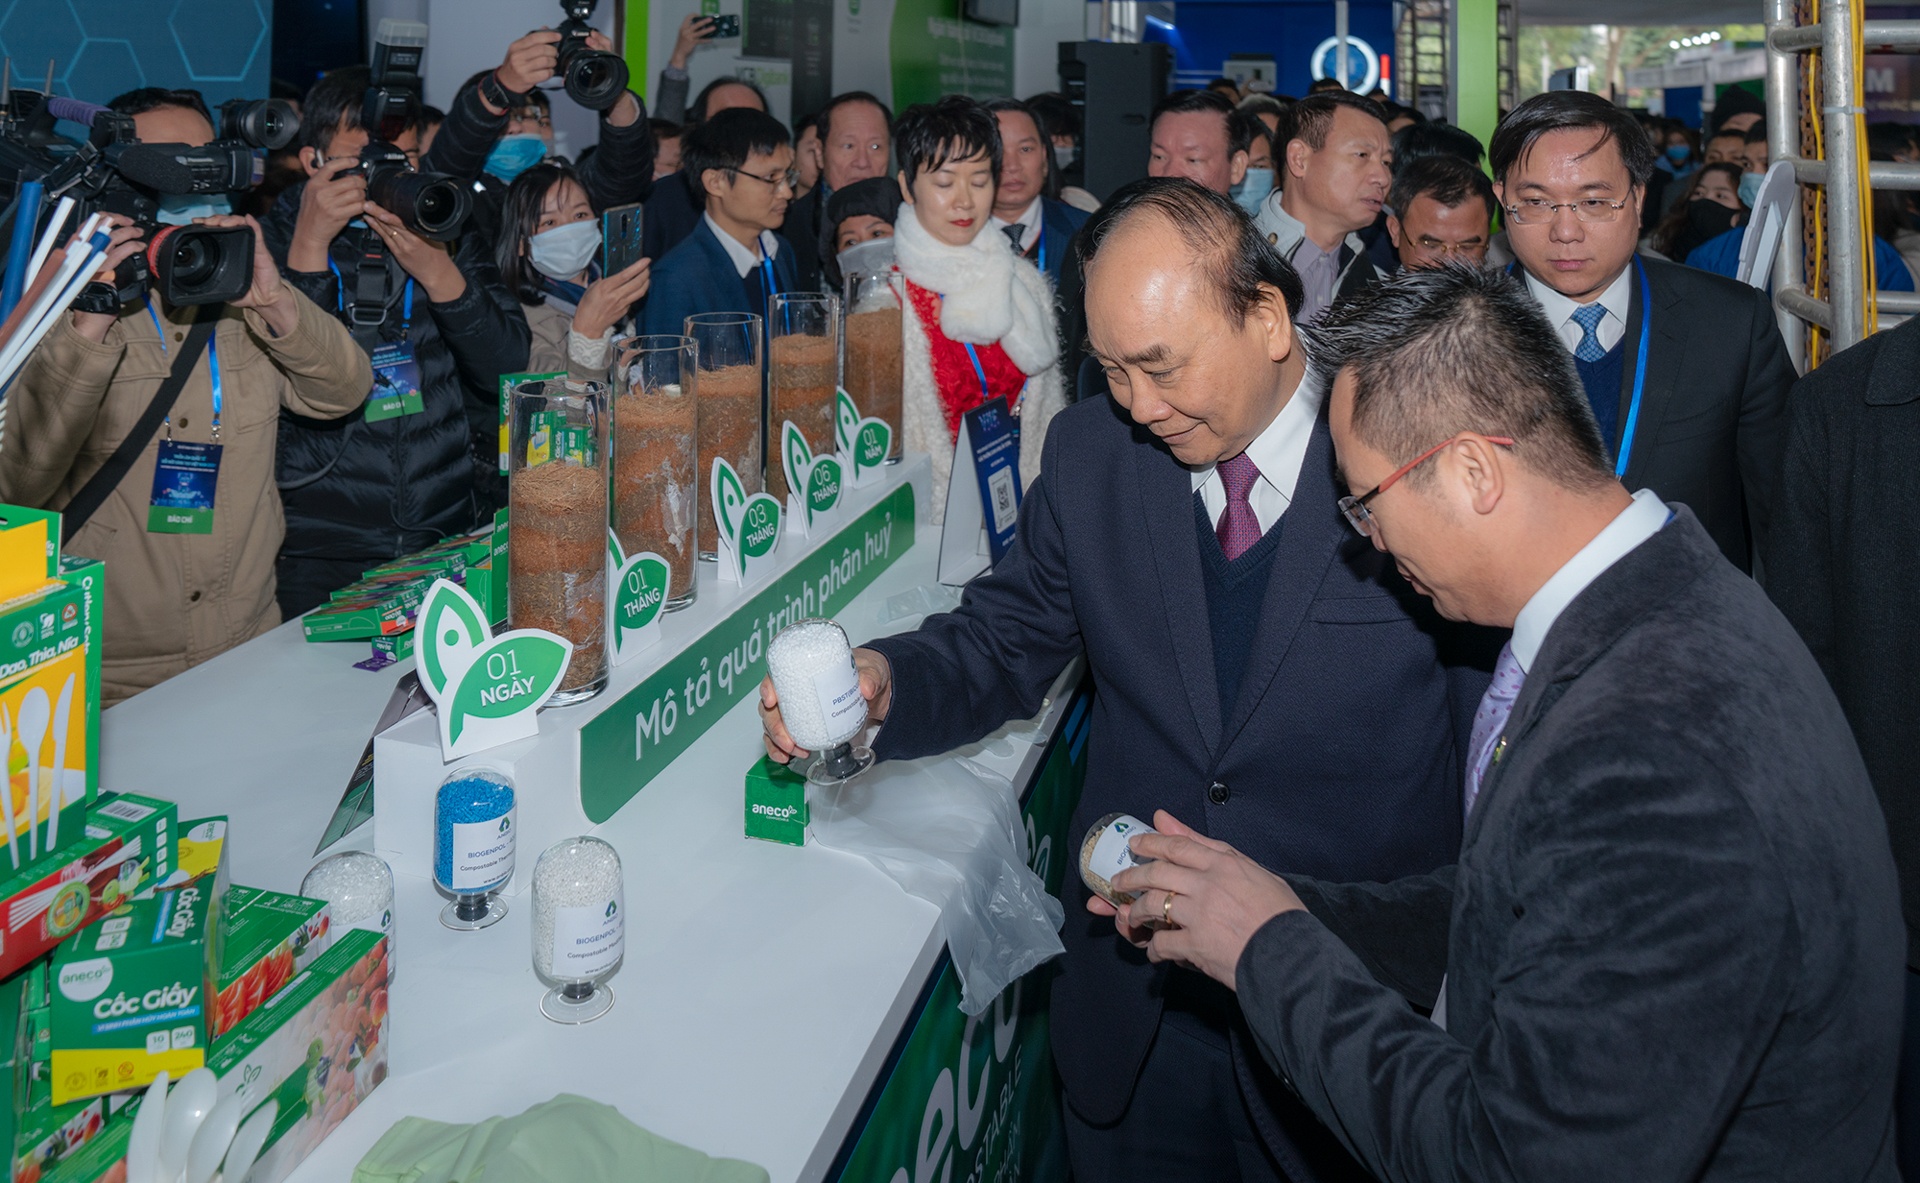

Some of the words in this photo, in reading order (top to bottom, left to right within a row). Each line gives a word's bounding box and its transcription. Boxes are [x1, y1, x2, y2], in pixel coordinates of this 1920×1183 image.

[863, 428, 878, 446] 01
[864, 445, 883, 460] NĂM
[814, 464, 831, 486] 06
[812, 482, 838, 503] THÁNG
[748, 504, 766, 527] 03
[746, 523, 775, 547] THÁNG
[628, 567, 648, 594] 01
[623, 587, 661, 617] THÁNG
[635, 687, 677, 761] Mô
[684, 657, 711, 717] tả
[717, 619, 762, 696] quá
[819, 547, 861, 616] phân
[865, 512, 892, 567] huỷ
[486, 649, 522, 680] 01
[480, 676, 535, 707] NGÀY
[752, 803, 790, 818] aneco
[467, 843, 507, 859] BIOGENPOL
[460, 860, 498, 872] Compostable
[576, 928, 616, 946] BIOGENPOL
[62, 968, 103, 985] aneco
[93, 991, 141, 1019] Cốc
[142, 981, 198, 1012] Giấy
